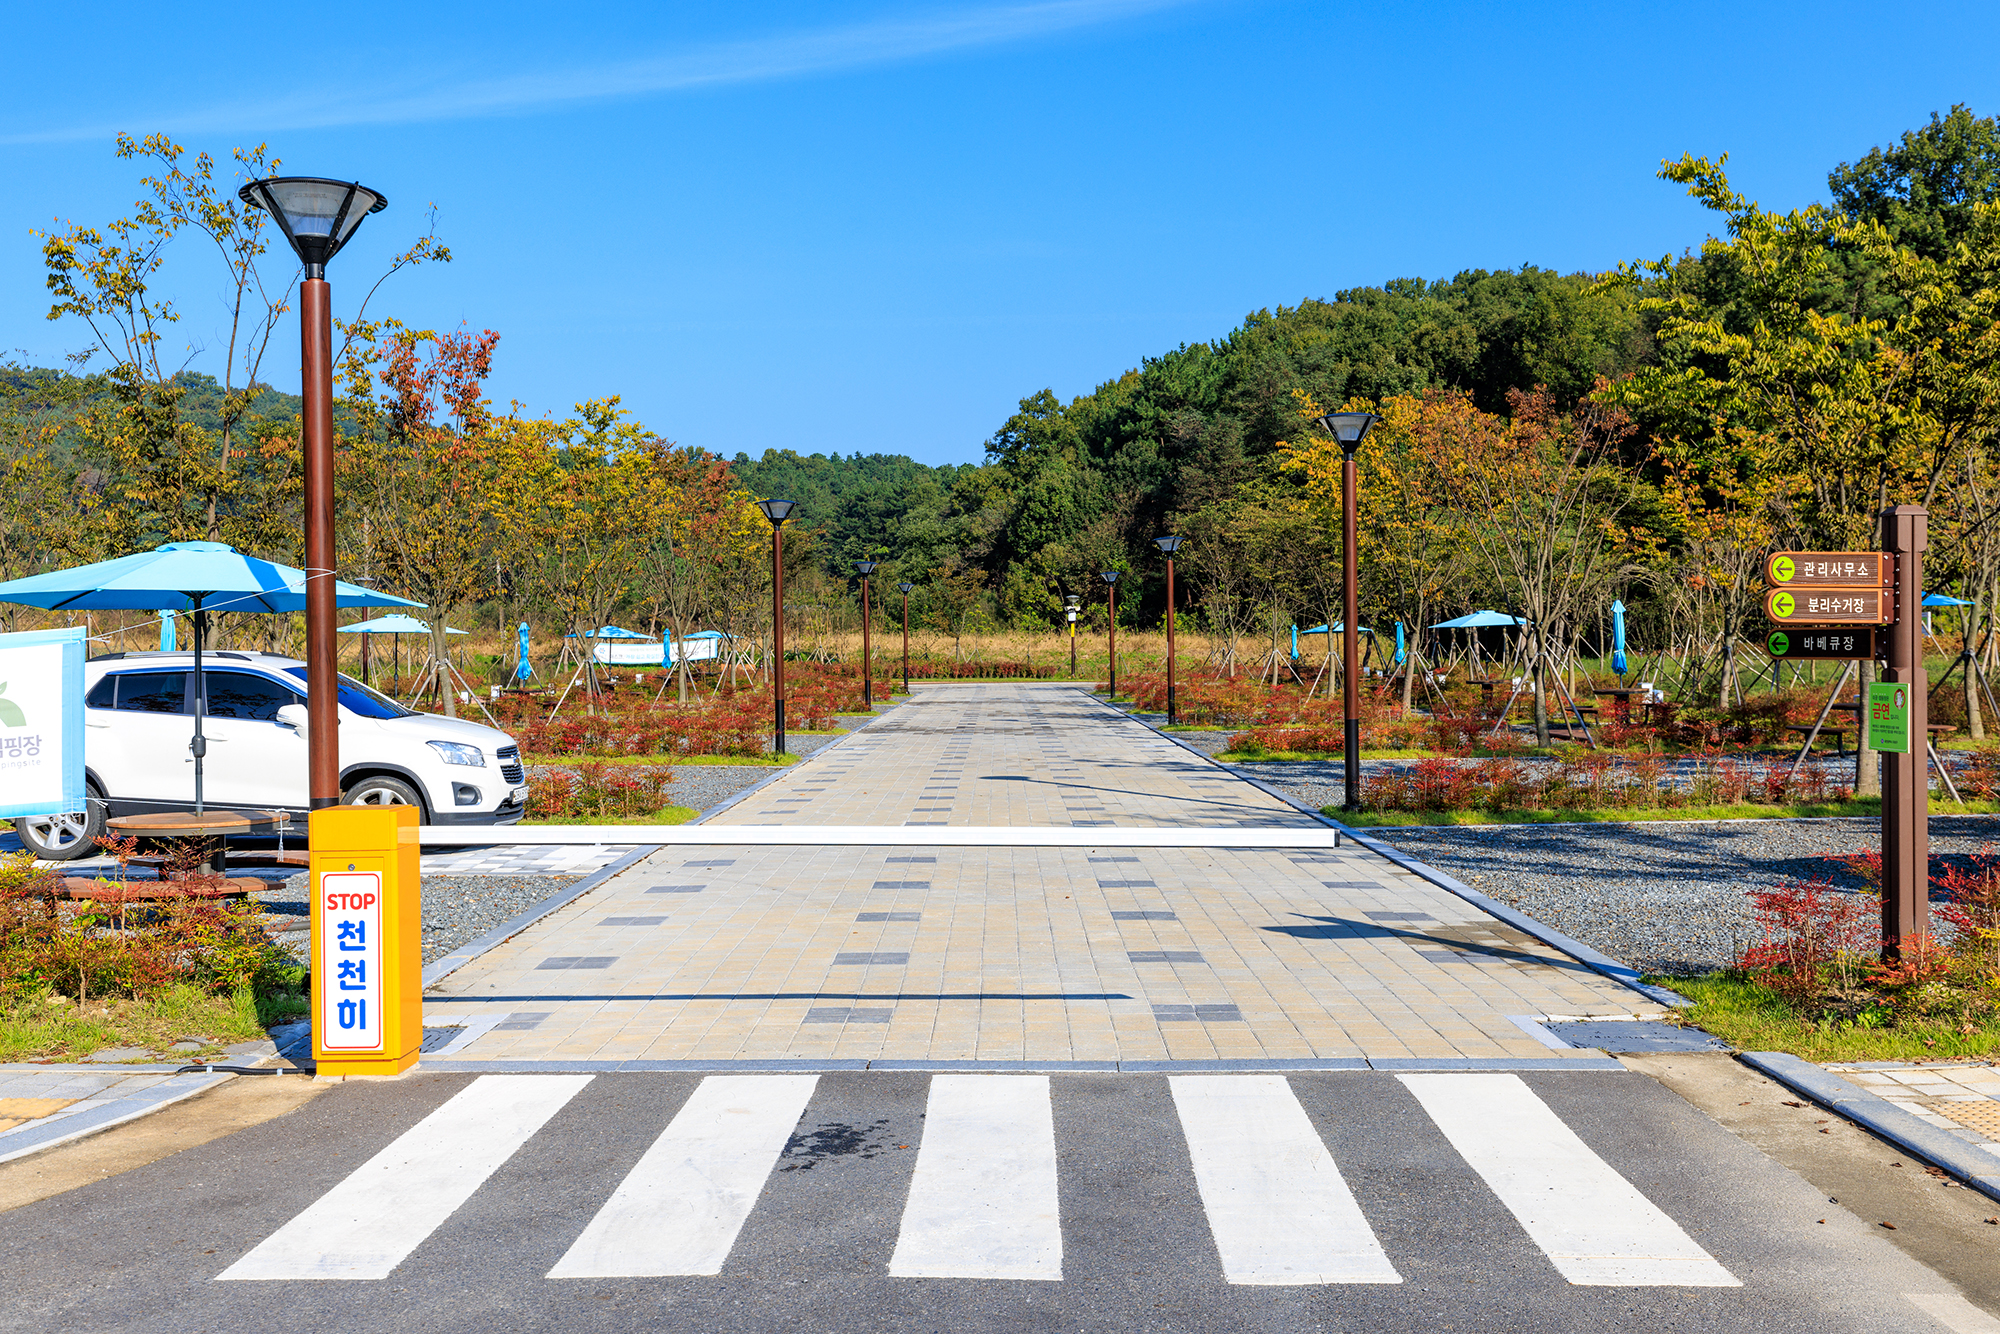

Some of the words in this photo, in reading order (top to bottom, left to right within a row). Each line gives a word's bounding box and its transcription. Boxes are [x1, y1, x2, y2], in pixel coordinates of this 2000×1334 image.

[1803, 561, 1869, 577] 관리사무소
[1807, 597, 1865, 613] 분리수거장
[1803, 636, 1854, 651] 바베큐장
[1872, 702, 1890, 720] 금연
[0, 734, 43, 759] 핑장
[327, 893, 376, 911] STOP
[337, 920, 367, 1030] 천천히
